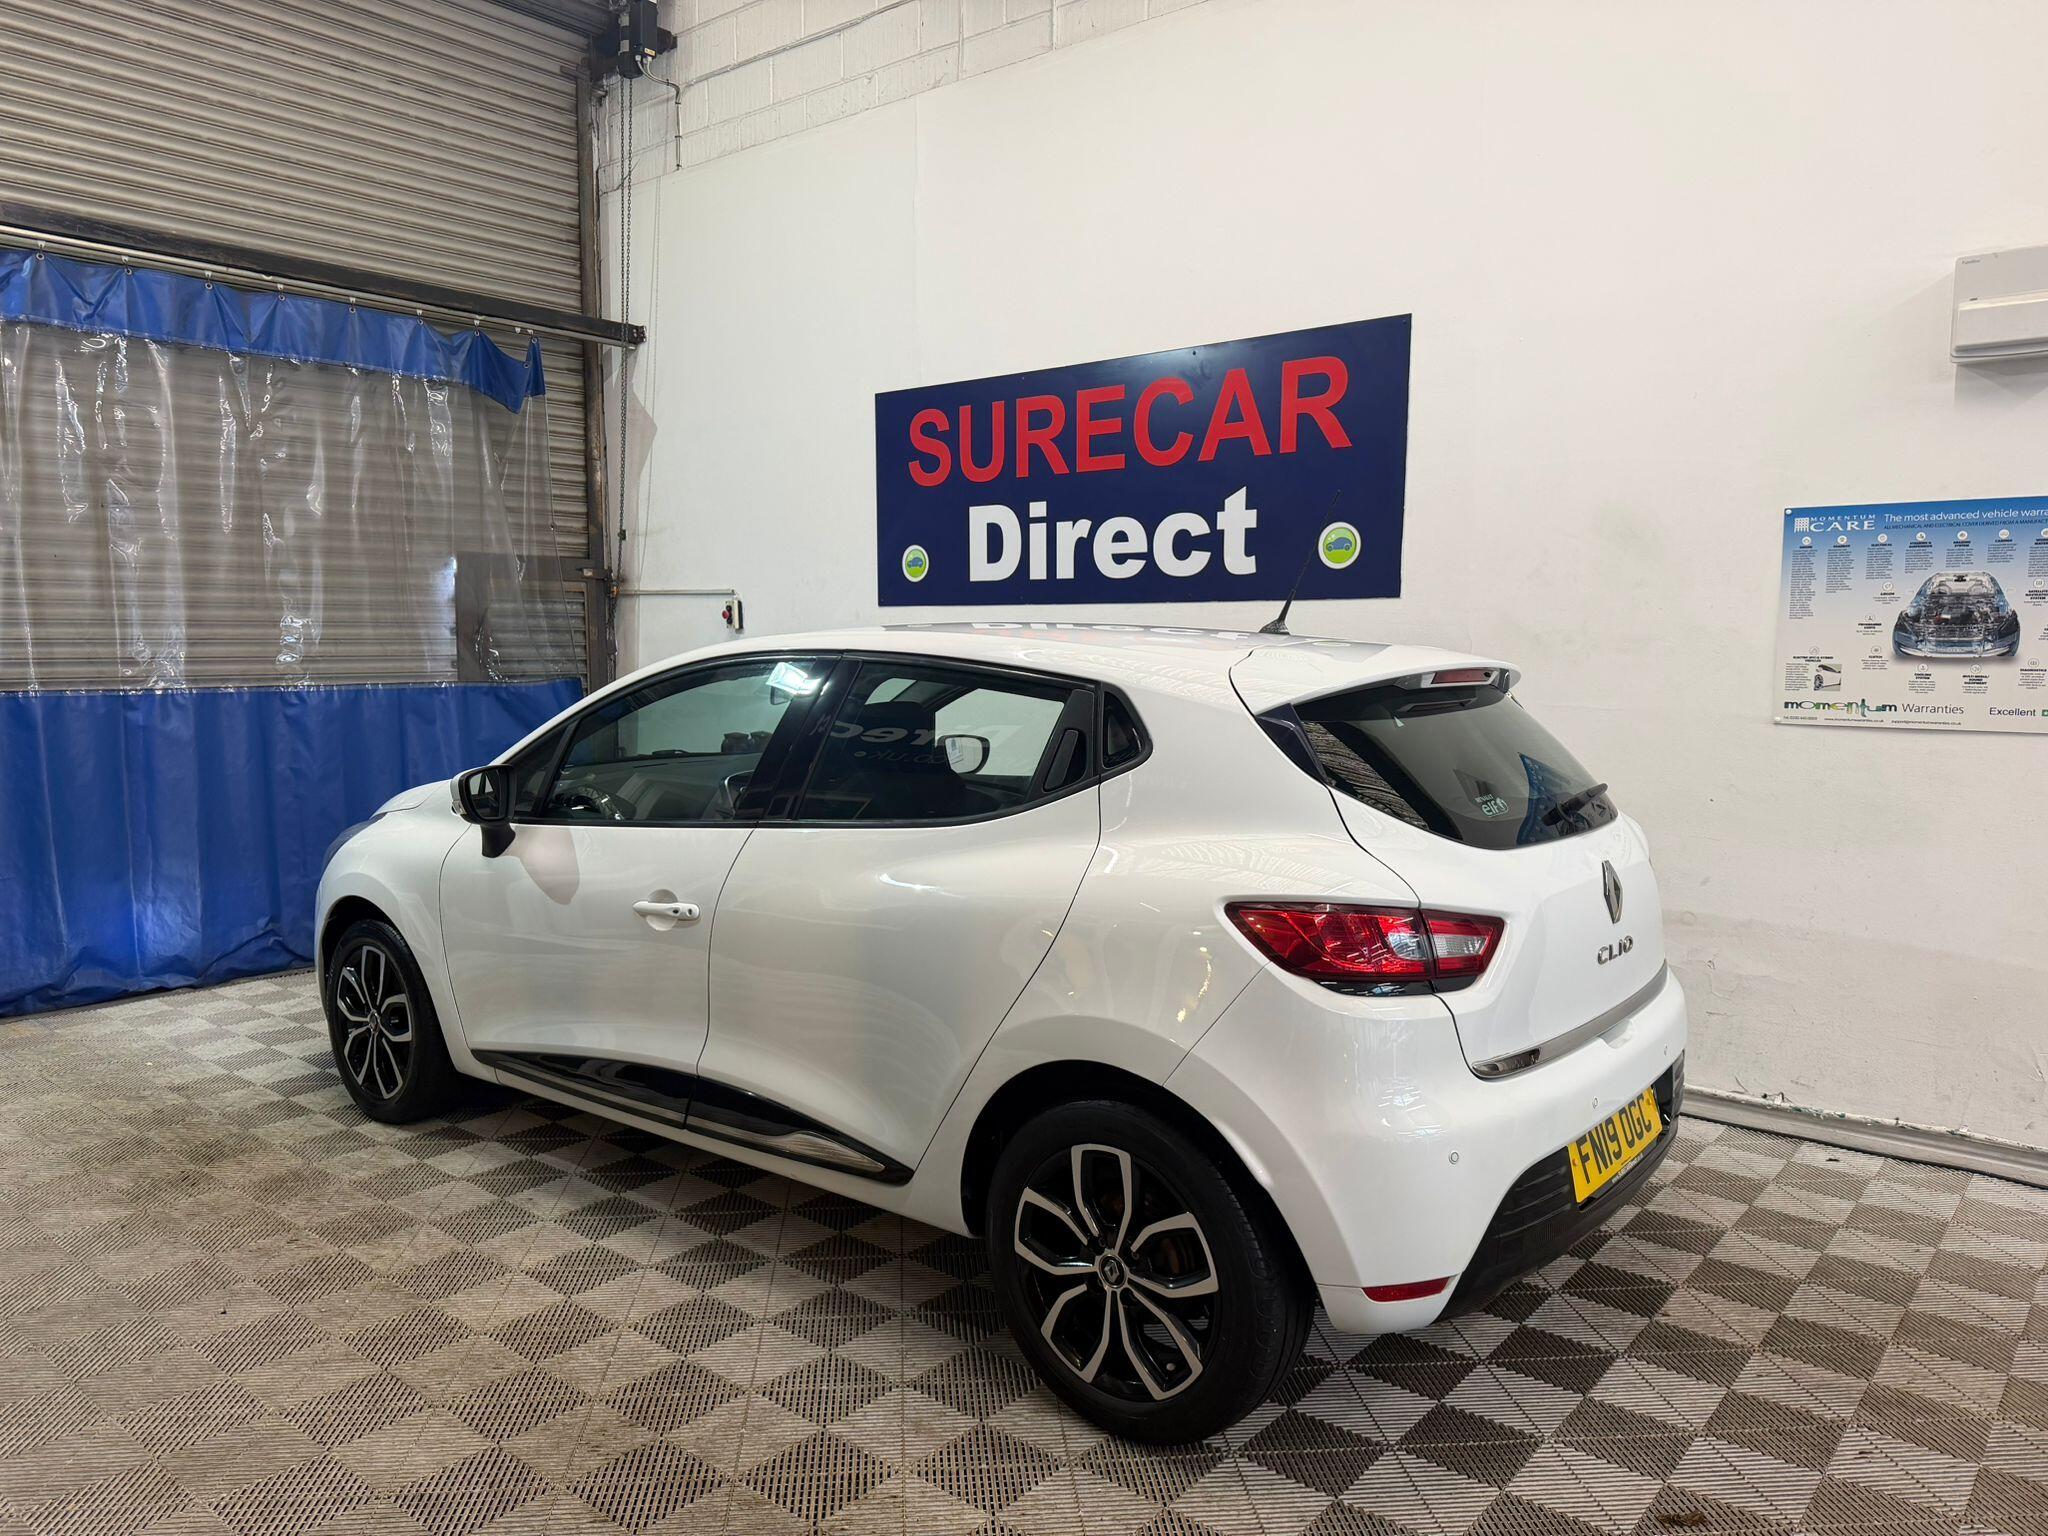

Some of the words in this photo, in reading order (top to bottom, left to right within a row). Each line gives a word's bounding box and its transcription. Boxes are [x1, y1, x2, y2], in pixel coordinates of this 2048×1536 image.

[907, 355, 1354, 487] SURECAR
[1884, 513, 1902, 522] The
[1904, 513, 1929, 522] most
[1929, 511, 1980, 522] advanced
[1981, 508, 2019, 519] vehicle
[968, 485, 1258, 582] Direct
[1810, 520, 1876, 532] CARE
[1784, 698, 1898, 718] momentum
[1901, 703, 1965, 715] Warranties
[1989, 707, 2036, 717] Excellent
[1481, 798, 1499, 816] elf
[1597, 935, 1634, 965] CLIO
[1575, 1116, 1623, 1184] FN19
[1618, 1093, 1653, 1149] OGC
